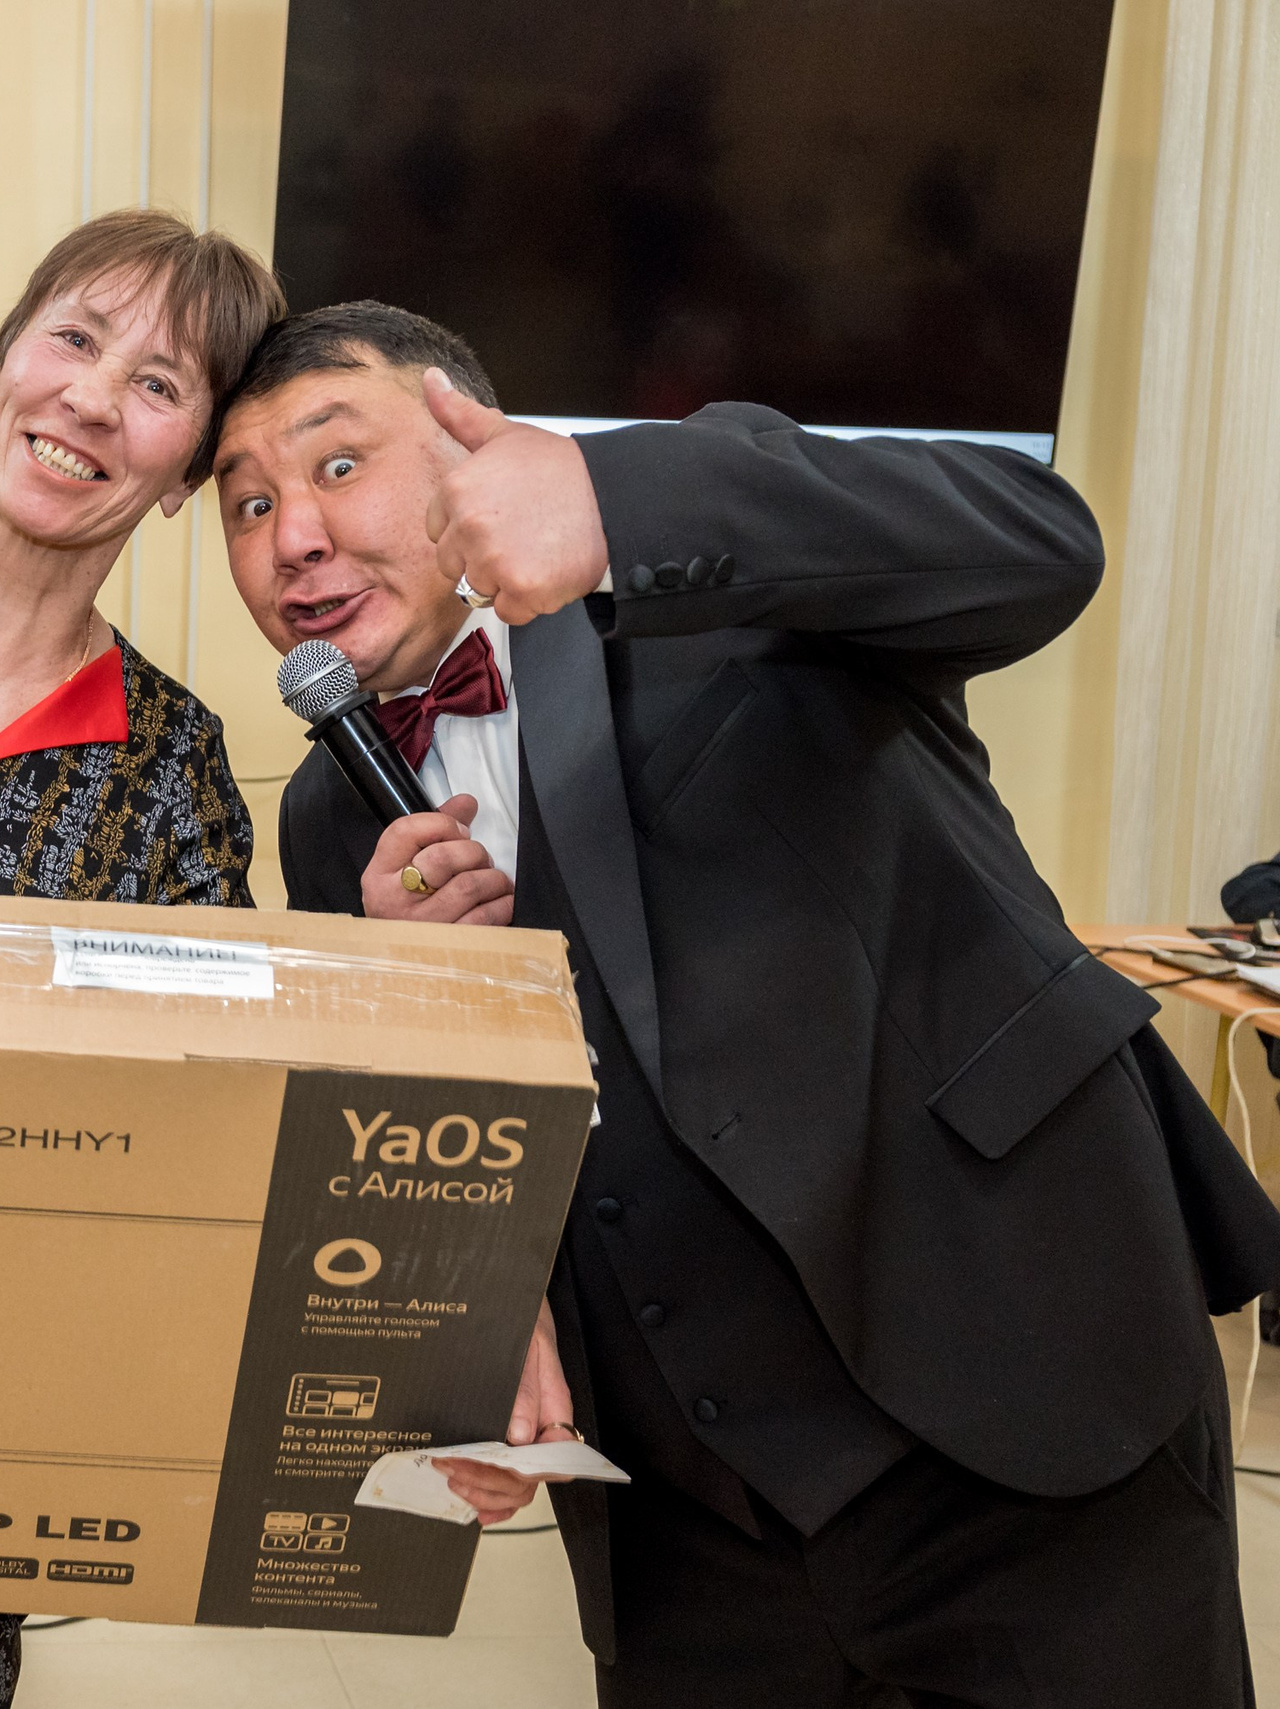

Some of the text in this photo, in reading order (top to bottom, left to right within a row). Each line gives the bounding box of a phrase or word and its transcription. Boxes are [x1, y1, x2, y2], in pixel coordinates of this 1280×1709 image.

[195, 967, 251, 978] содержимое
[342, 1108, 527, 1170] YaOS
[328, 1170, 514, 1205] с Алисой
[306, 1293, 380, 1312] Внутри
[406, 1298, 468, 1315] Алиса
[304, 1312, 440, 1328] Управляйте голосом
[301, 1325, 421, 1340] с помощью пульта
[282, 1424, 433, 1442] Все интересное
[279, 1441, 427, 1455] на одном экра
[276, 1455, 314, 1467] Легко
[274, 1468, 282, 1476] и
[284, 1468, 345, 1479] смотрите
[34, 1514, 142, 1543] LED
[257, 1558, 361, 1574] Множество
[254, 1572, 336, 1586] контента
[249, 1596, 320, 1606] телеканалы
[333, 1600, 378, 1610] музыка
